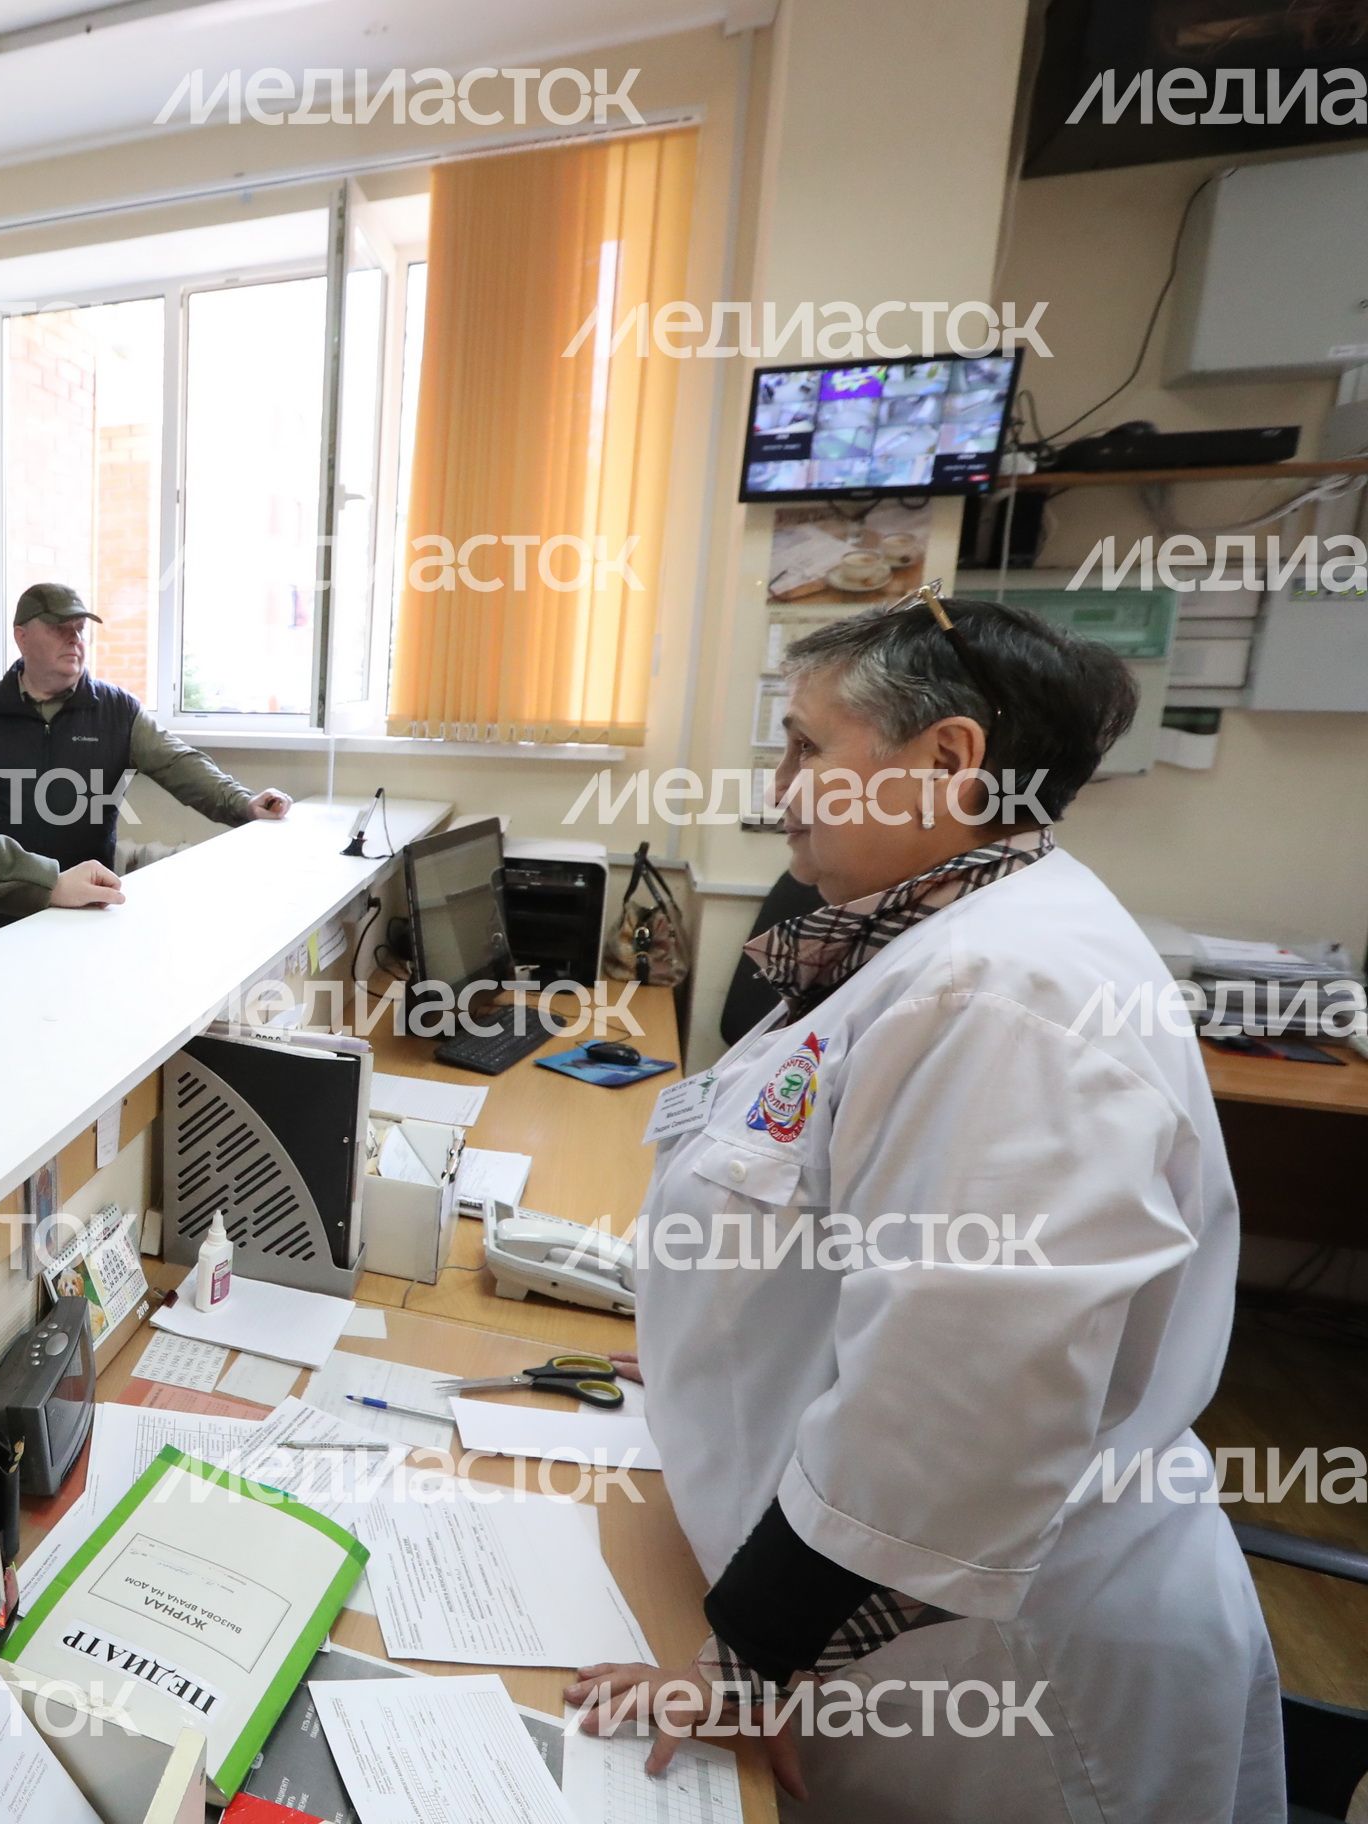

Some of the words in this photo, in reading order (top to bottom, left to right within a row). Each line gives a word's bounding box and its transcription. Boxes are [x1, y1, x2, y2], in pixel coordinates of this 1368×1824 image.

[136, 1300, 150, 1320] 2018
[125, 1576, 150, 1590] ДОМ
[152, 1586, 164, 1597] НА
[166, 1594, 198, 1612] ВРАЧА
[144, 1596, 208, 1632] ЖУРНАЛ
[201, 1608, 242, 1634] ВЫЗОВА
[62, 1630, 218, 1715] ПЕДИАТР
